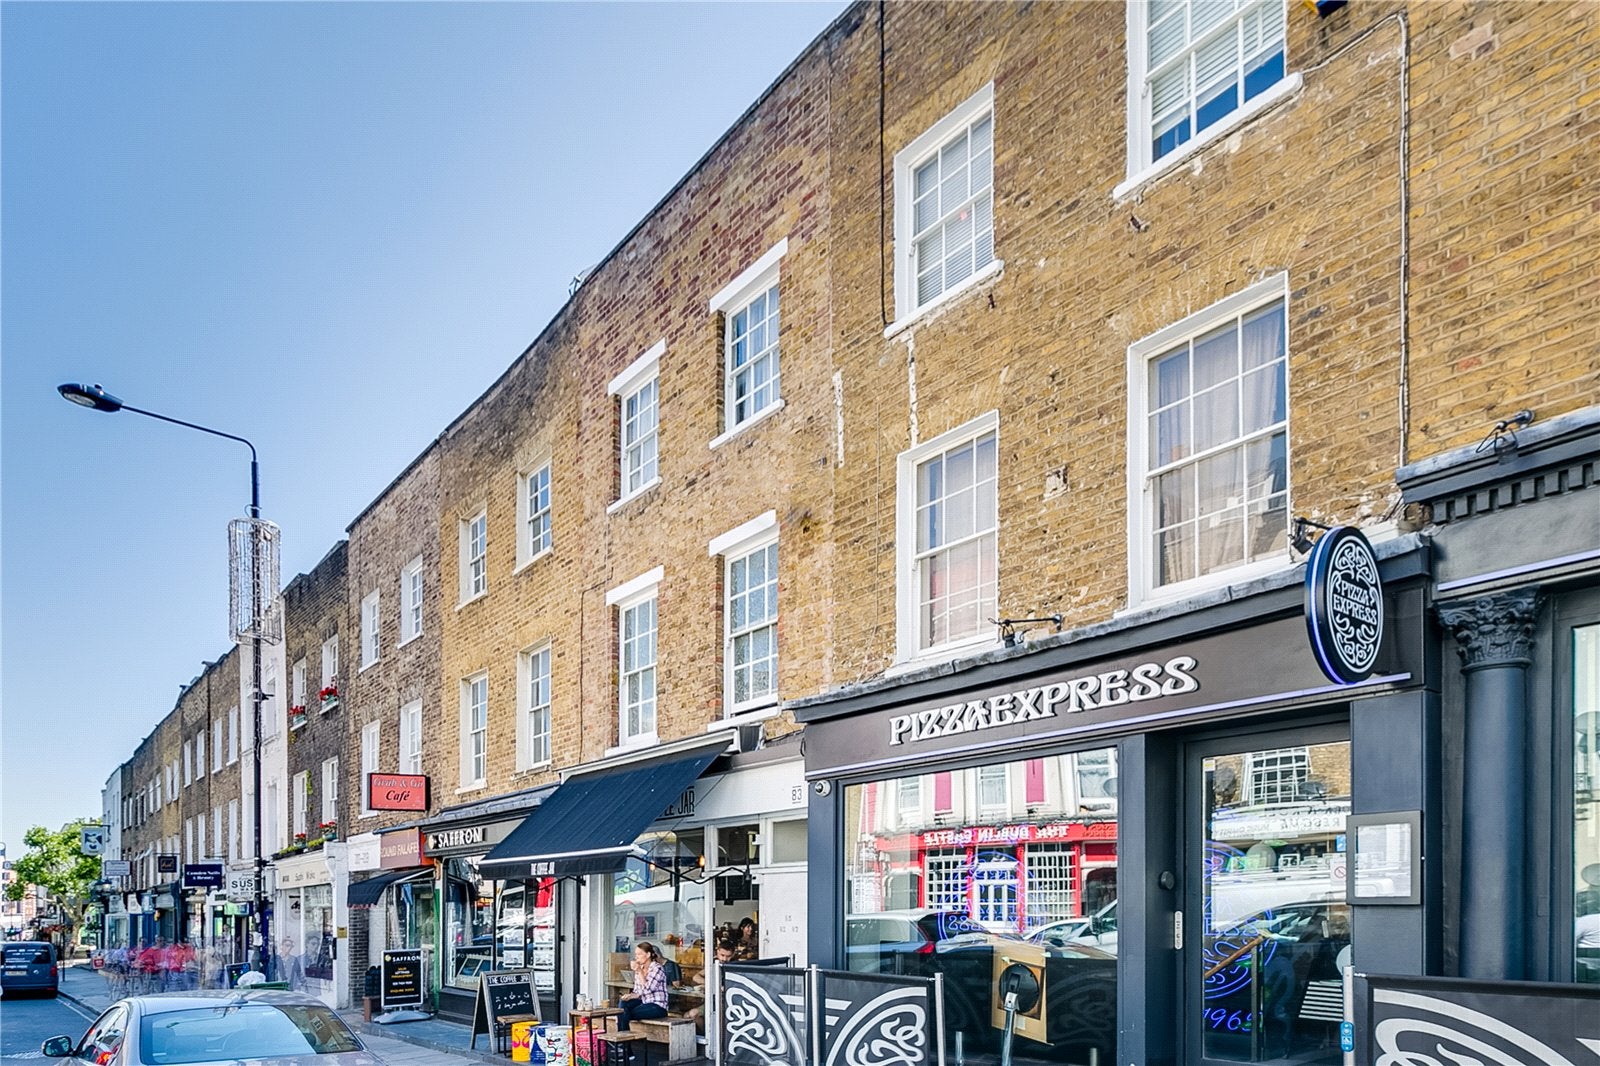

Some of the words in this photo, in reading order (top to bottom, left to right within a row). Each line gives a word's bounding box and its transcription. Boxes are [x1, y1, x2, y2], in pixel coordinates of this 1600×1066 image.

[1341, 580, 1369, 606] PIZZA
[1333, 594, 1377, 625] EXPRESS
[889, 656, 1198, 746] PIZZAEXPRESS
[400, 778, 408, 788] &
[385, 790, 410, 803] Café
[678, 791, 695, 814] JAR
[792, 788, 802, 801] 83
[438, 828, 482, 848] SAFFRON
[392, 955, 421, 963] SAFFRON
[488, 976, 498, 984] THE
[500, 974, 517, 984] COFFEE
